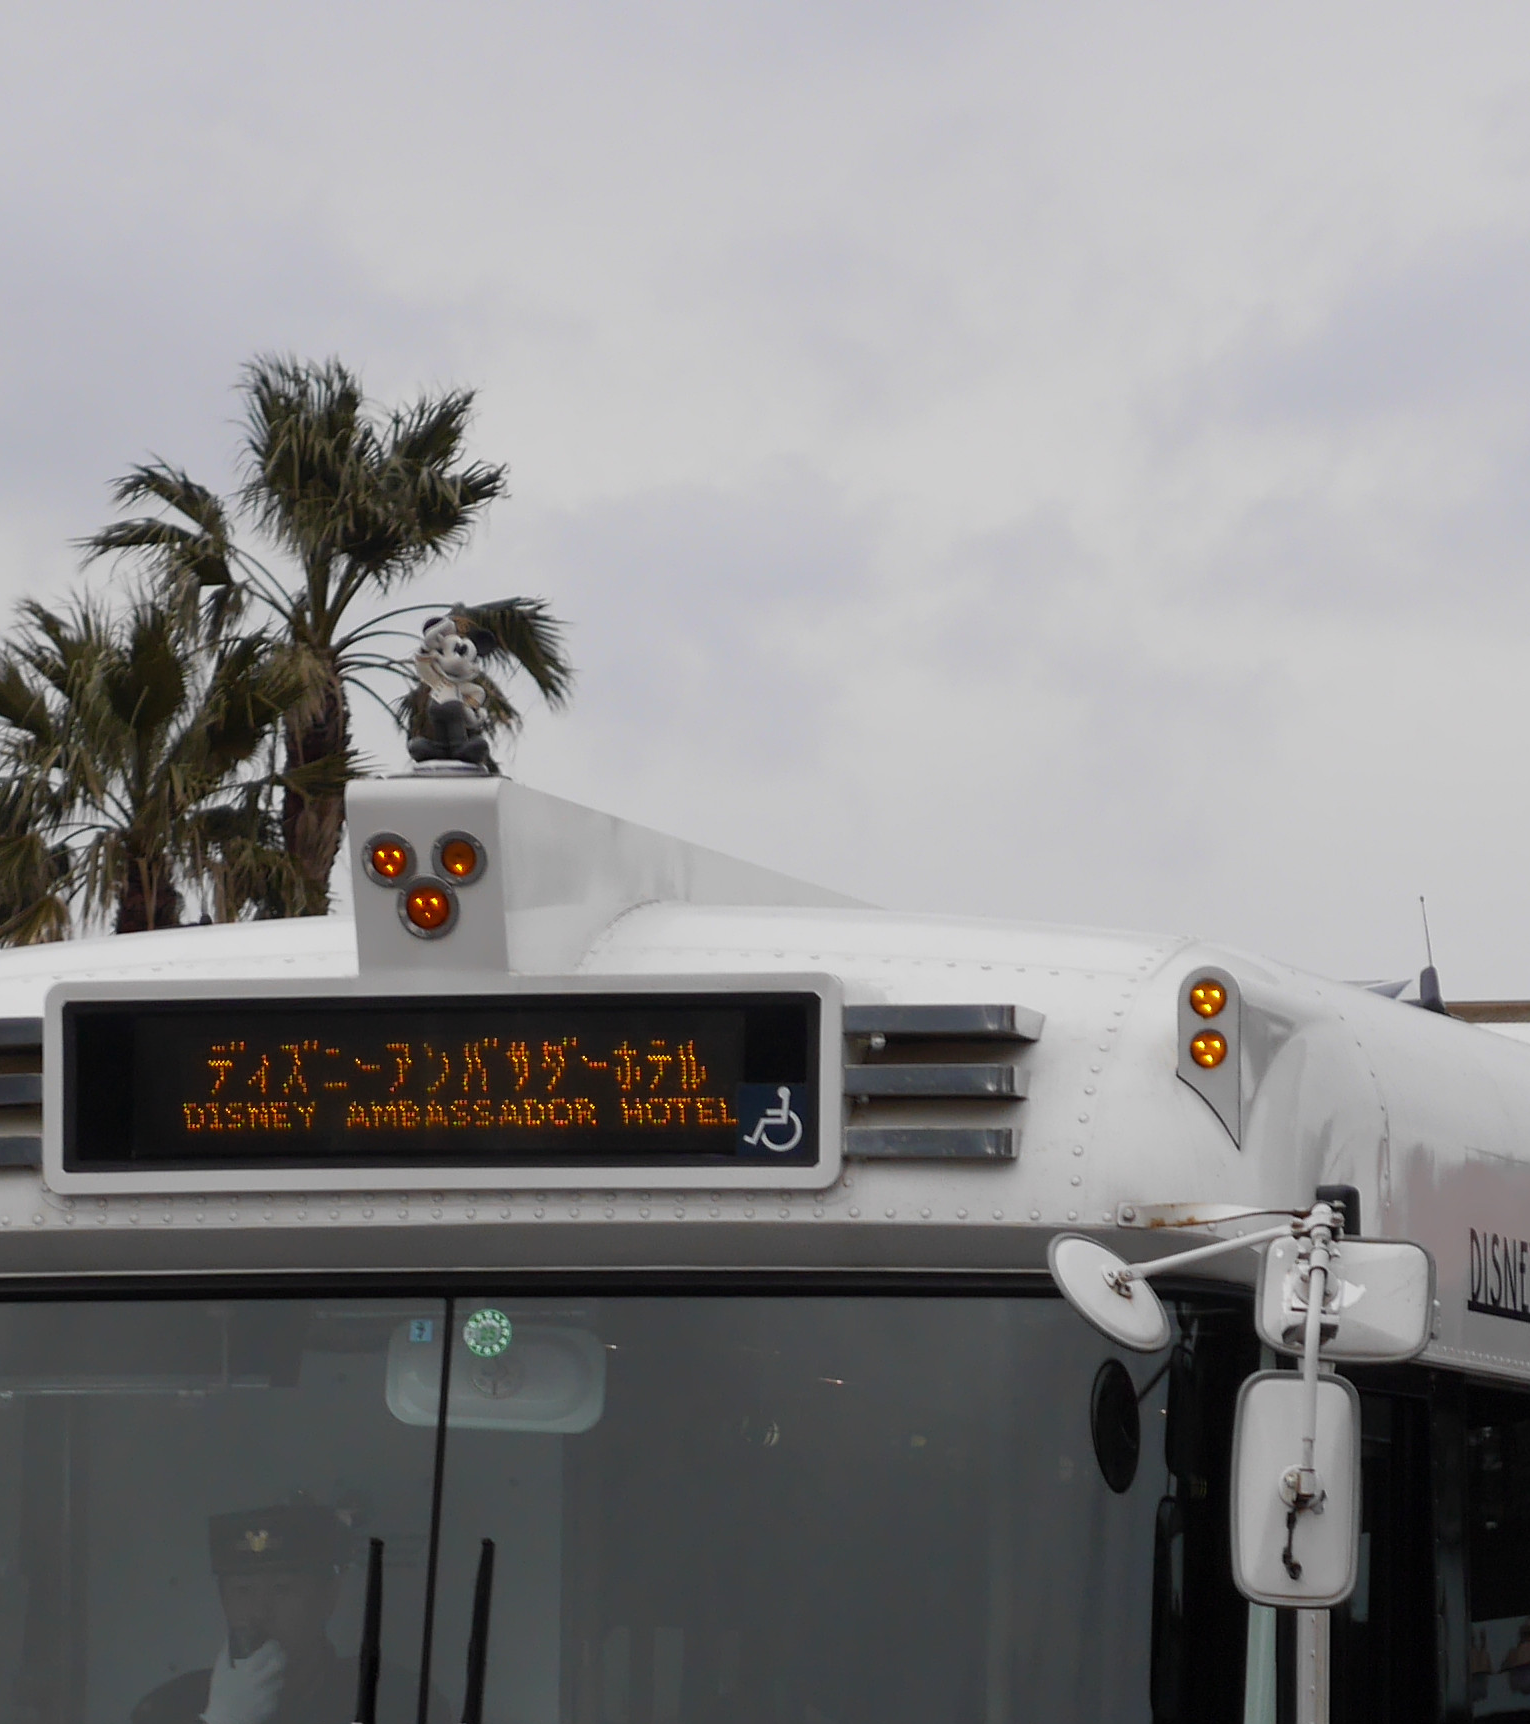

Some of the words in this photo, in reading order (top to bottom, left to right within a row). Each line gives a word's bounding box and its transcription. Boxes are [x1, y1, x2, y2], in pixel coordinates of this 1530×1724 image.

[181, 1100, 316, 1131] DISNEY
[346, 1098, 599, 1129] AMBASSADOR
[621, 1096, 737, 1126] HOTEL
